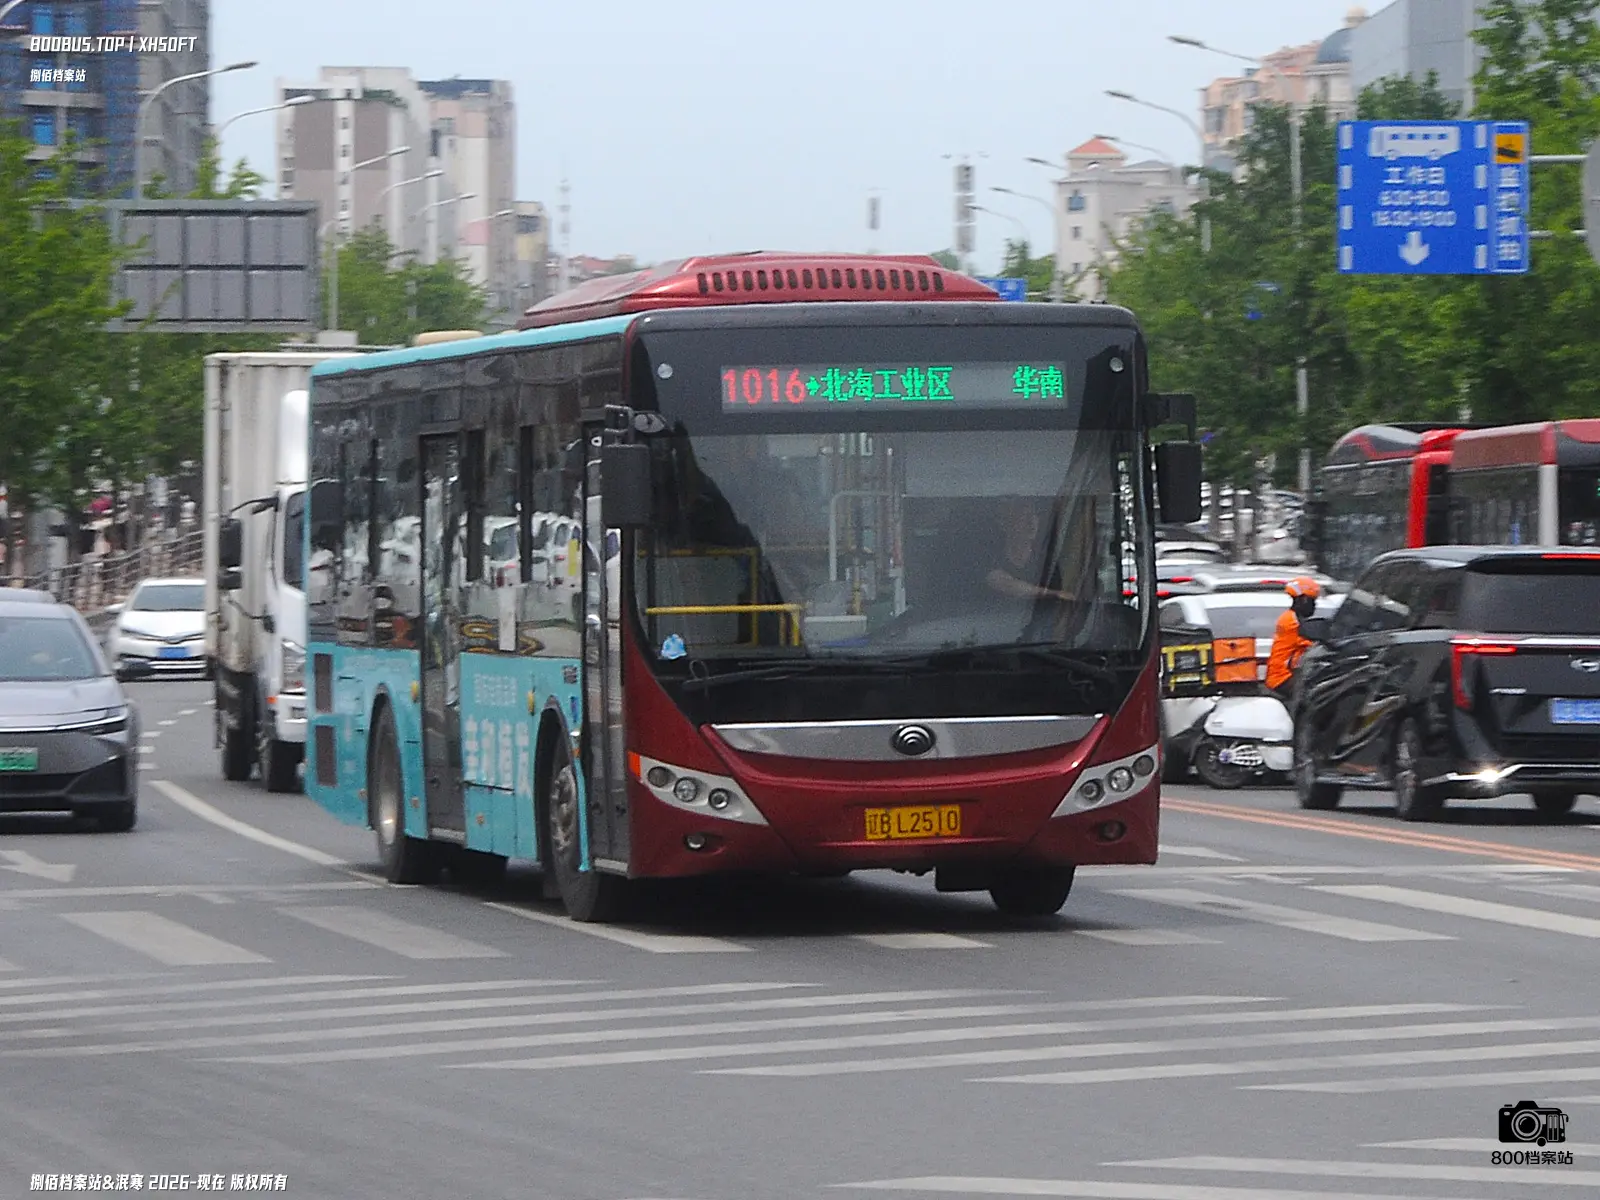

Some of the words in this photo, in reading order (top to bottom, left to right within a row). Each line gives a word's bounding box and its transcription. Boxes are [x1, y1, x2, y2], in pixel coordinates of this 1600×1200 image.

[1383, 166, 1445, 184] 工作日
[721, 368, 806, 404] 1016
[820, 366, 954, 401] 北海工业区
[1012, 364, 1064, 399] 华南
